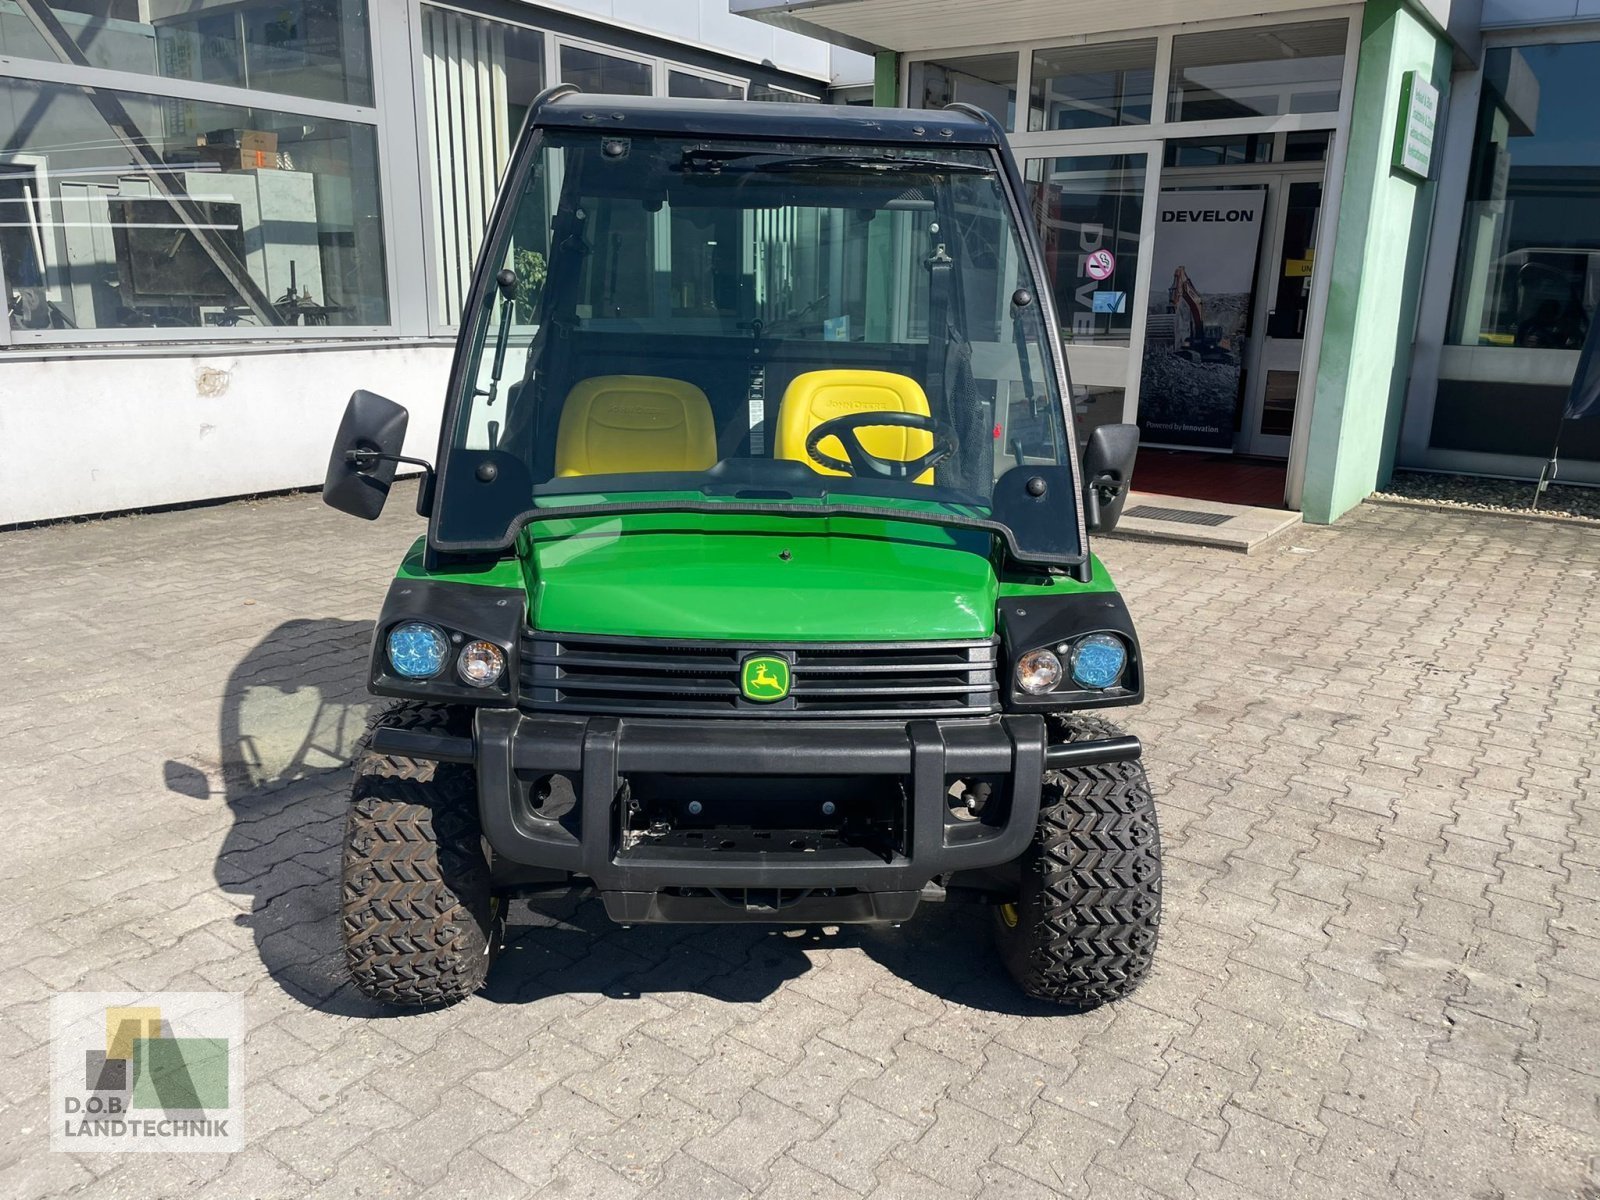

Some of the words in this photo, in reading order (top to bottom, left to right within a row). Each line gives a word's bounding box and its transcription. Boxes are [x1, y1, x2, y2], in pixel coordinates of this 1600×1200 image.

[1161, 210, 1254, 222] DEVELON
[1146, 421, 1173, 430] Powered
[1174, 423, 1182, 431] by
[1182, 424, 1219, 433] Innovation
